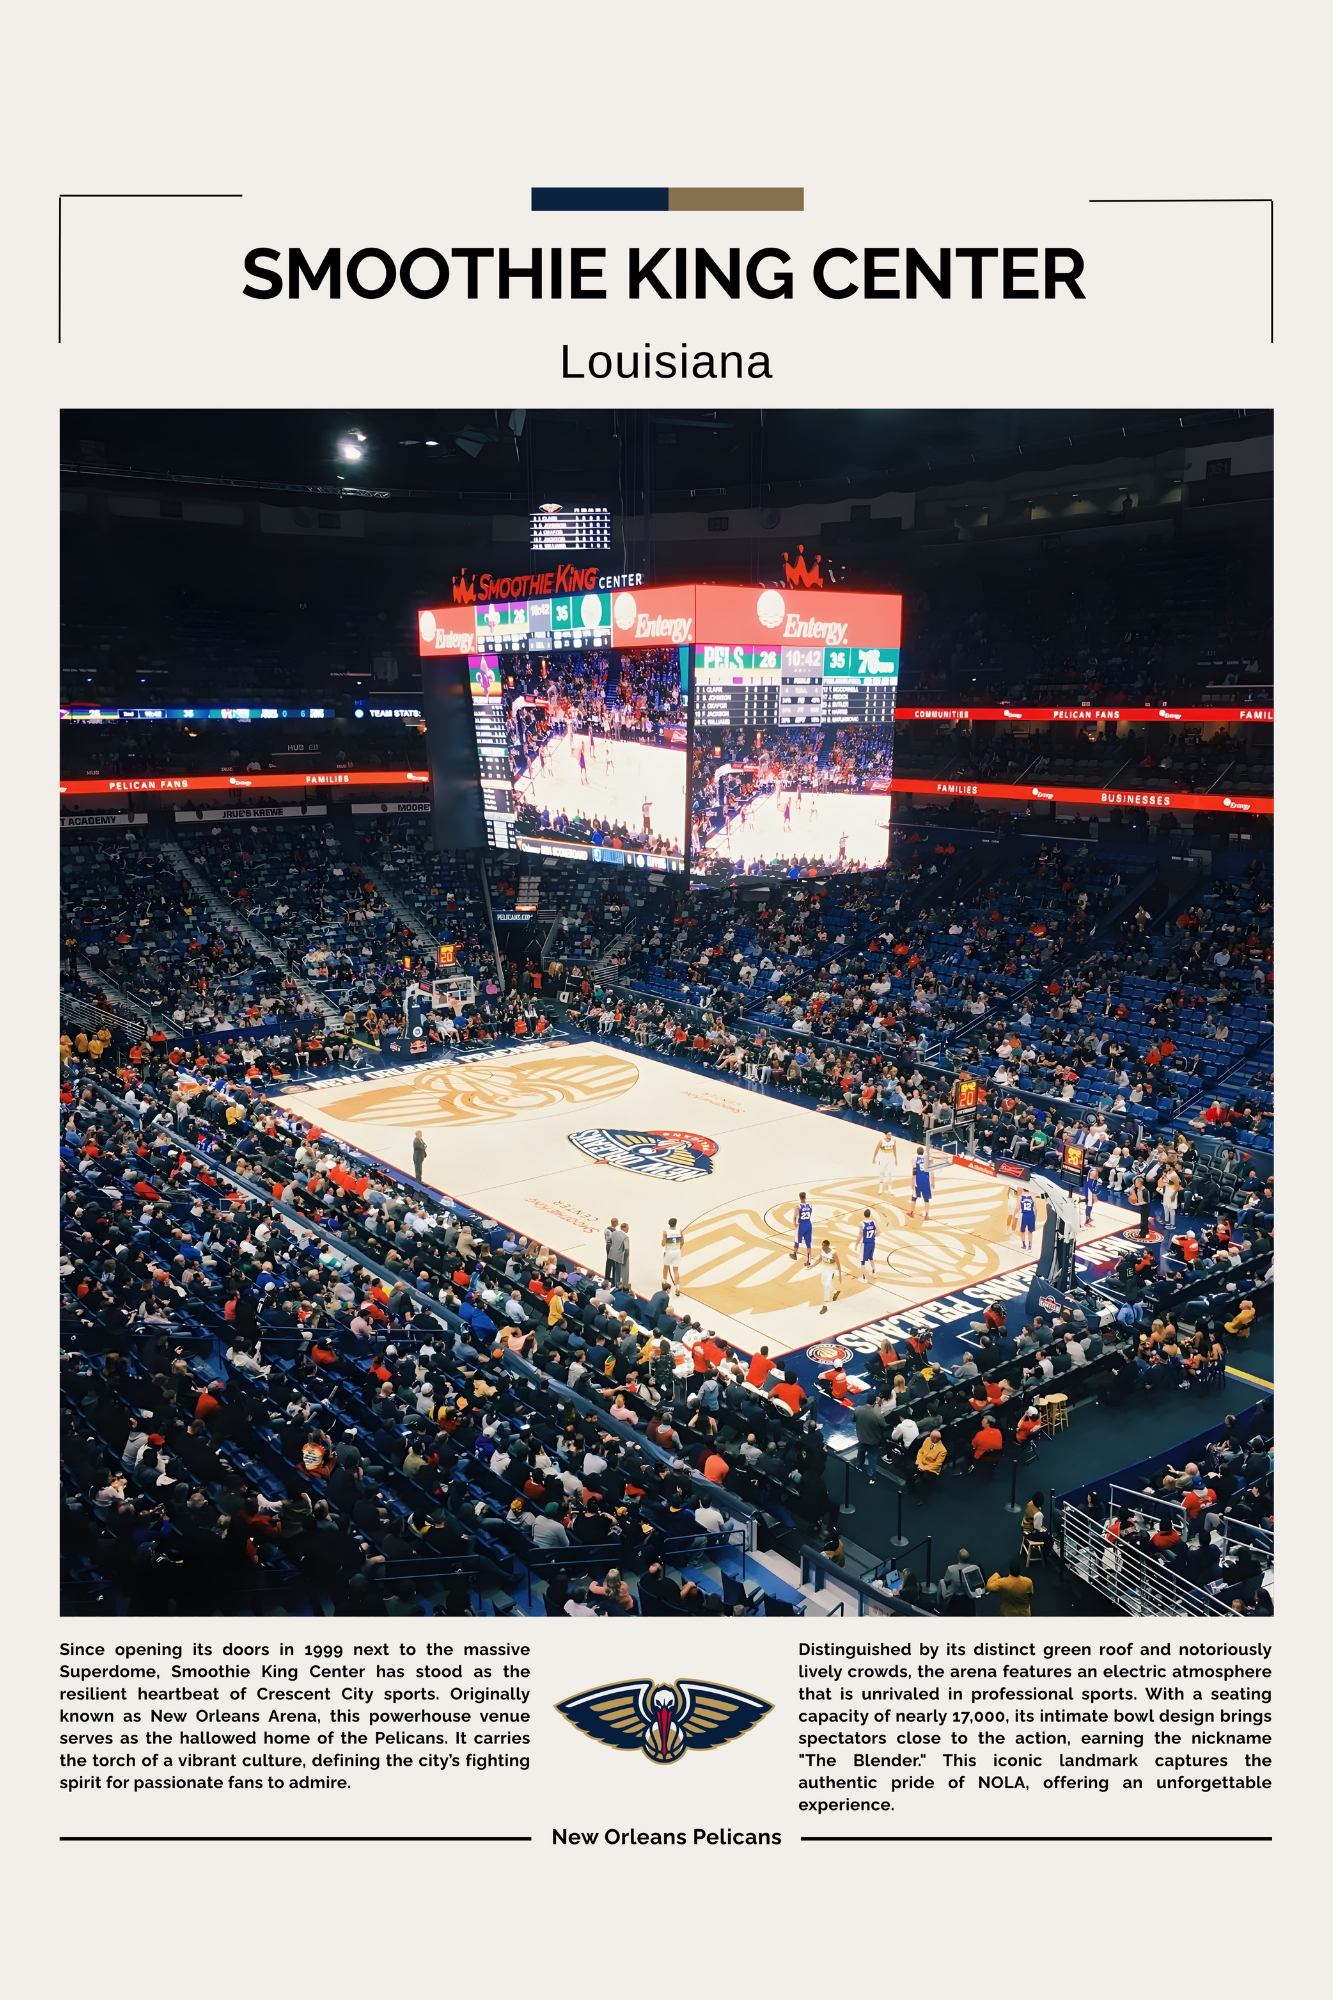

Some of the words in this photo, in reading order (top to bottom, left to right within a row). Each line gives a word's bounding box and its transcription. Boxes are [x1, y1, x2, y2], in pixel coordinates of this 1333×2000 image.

[477, 573, 554, 600] SMOOTHIE
[598, 573, 643, 589] CENTER
[513, 608, 525, 624] 26
[555, 605, 569, 622] 35
[704, 646, 744, 669] PELS
[759, 651, 777, 668] 26
[785, 649, 821, 667] 10:42
[829, 652, 846, 669] 35
[369, 709, 393, 718] TEAM
[394, 709, 422, 718] STATS:
[914, 710, 969, 719] COMMUNITIES
[1053, 710, 1092, 719] PELICAN
[1095, 710, 1120, 719] FANS
[1239, 710, 1273, 720] FAMIL
[109, 781, 156, 790] PELICAN
[161, 780, 188, 788] FANS
[306, 775, 349, 783] FAMILIES
[937, 784, 978, 794] FAMILIES
[1101, 793, 1171, 806] BUSINESSES
[253, 809, 284, 817] KREWE
[68, 816, 116, 826] ACADEMY
[441, 952, 453, 963] 20
[305, 1074, 364, 1090] NEW
[364, 1058, 460, 1079] ORLEANS
[960, 1091, 974, 1107] 20
[569, 1129, 645, 1166] ORLEANS
[630, 1162, 709, 1182] NEW
[1023, 1202, 1032, 1211] 12
[800, 1211, 811, 1220] 23
[866, 1230, 875, 1239] 17
[1074, 1235, 1146, 1266] NEW
[836, 1295, 984, 1354] PELICANS
